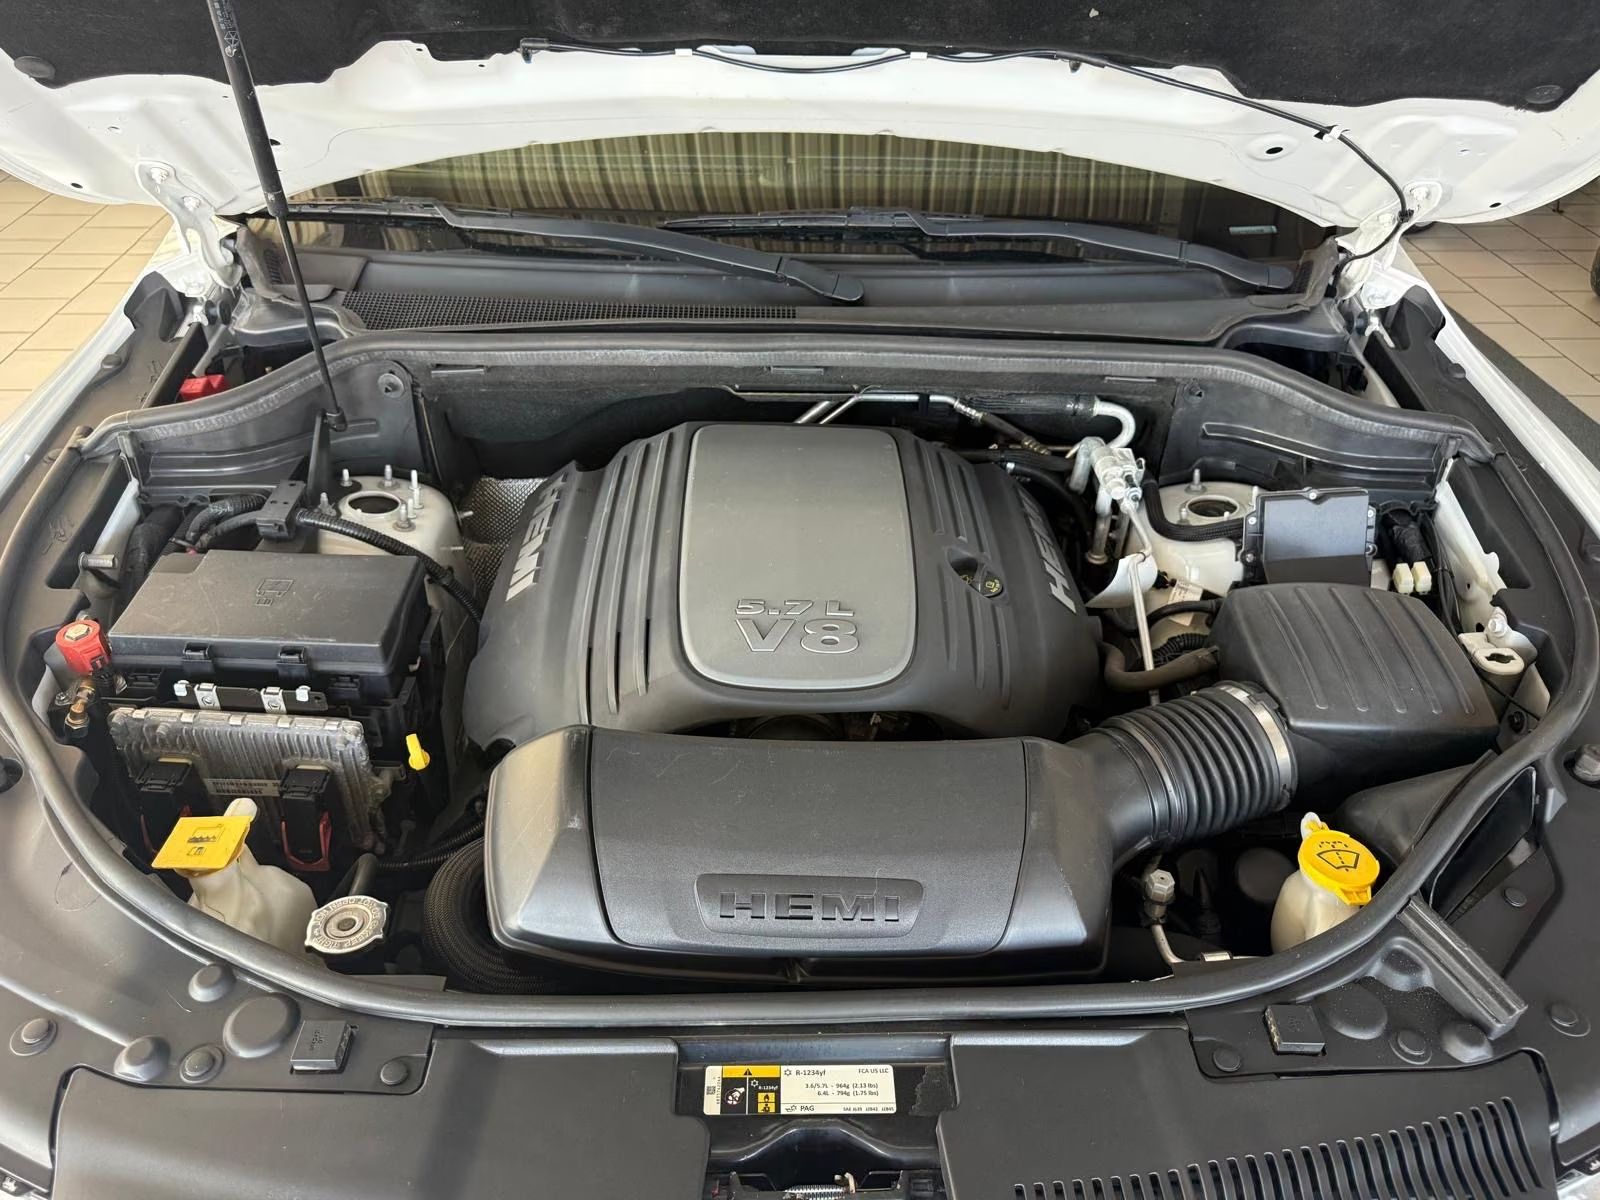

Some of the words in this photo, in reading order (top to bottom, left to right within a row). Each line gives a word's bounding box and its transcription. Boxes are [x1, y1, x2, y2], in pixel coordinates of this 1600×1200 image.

[505, 472, 564, 602] HEMI
[1017, 485, 1077, 614] HEMI
[735, 618, 859, 654] V8
[719, 891, 901, 922] HEMI
[795, 1069, 826, 1077] R-1234yf
